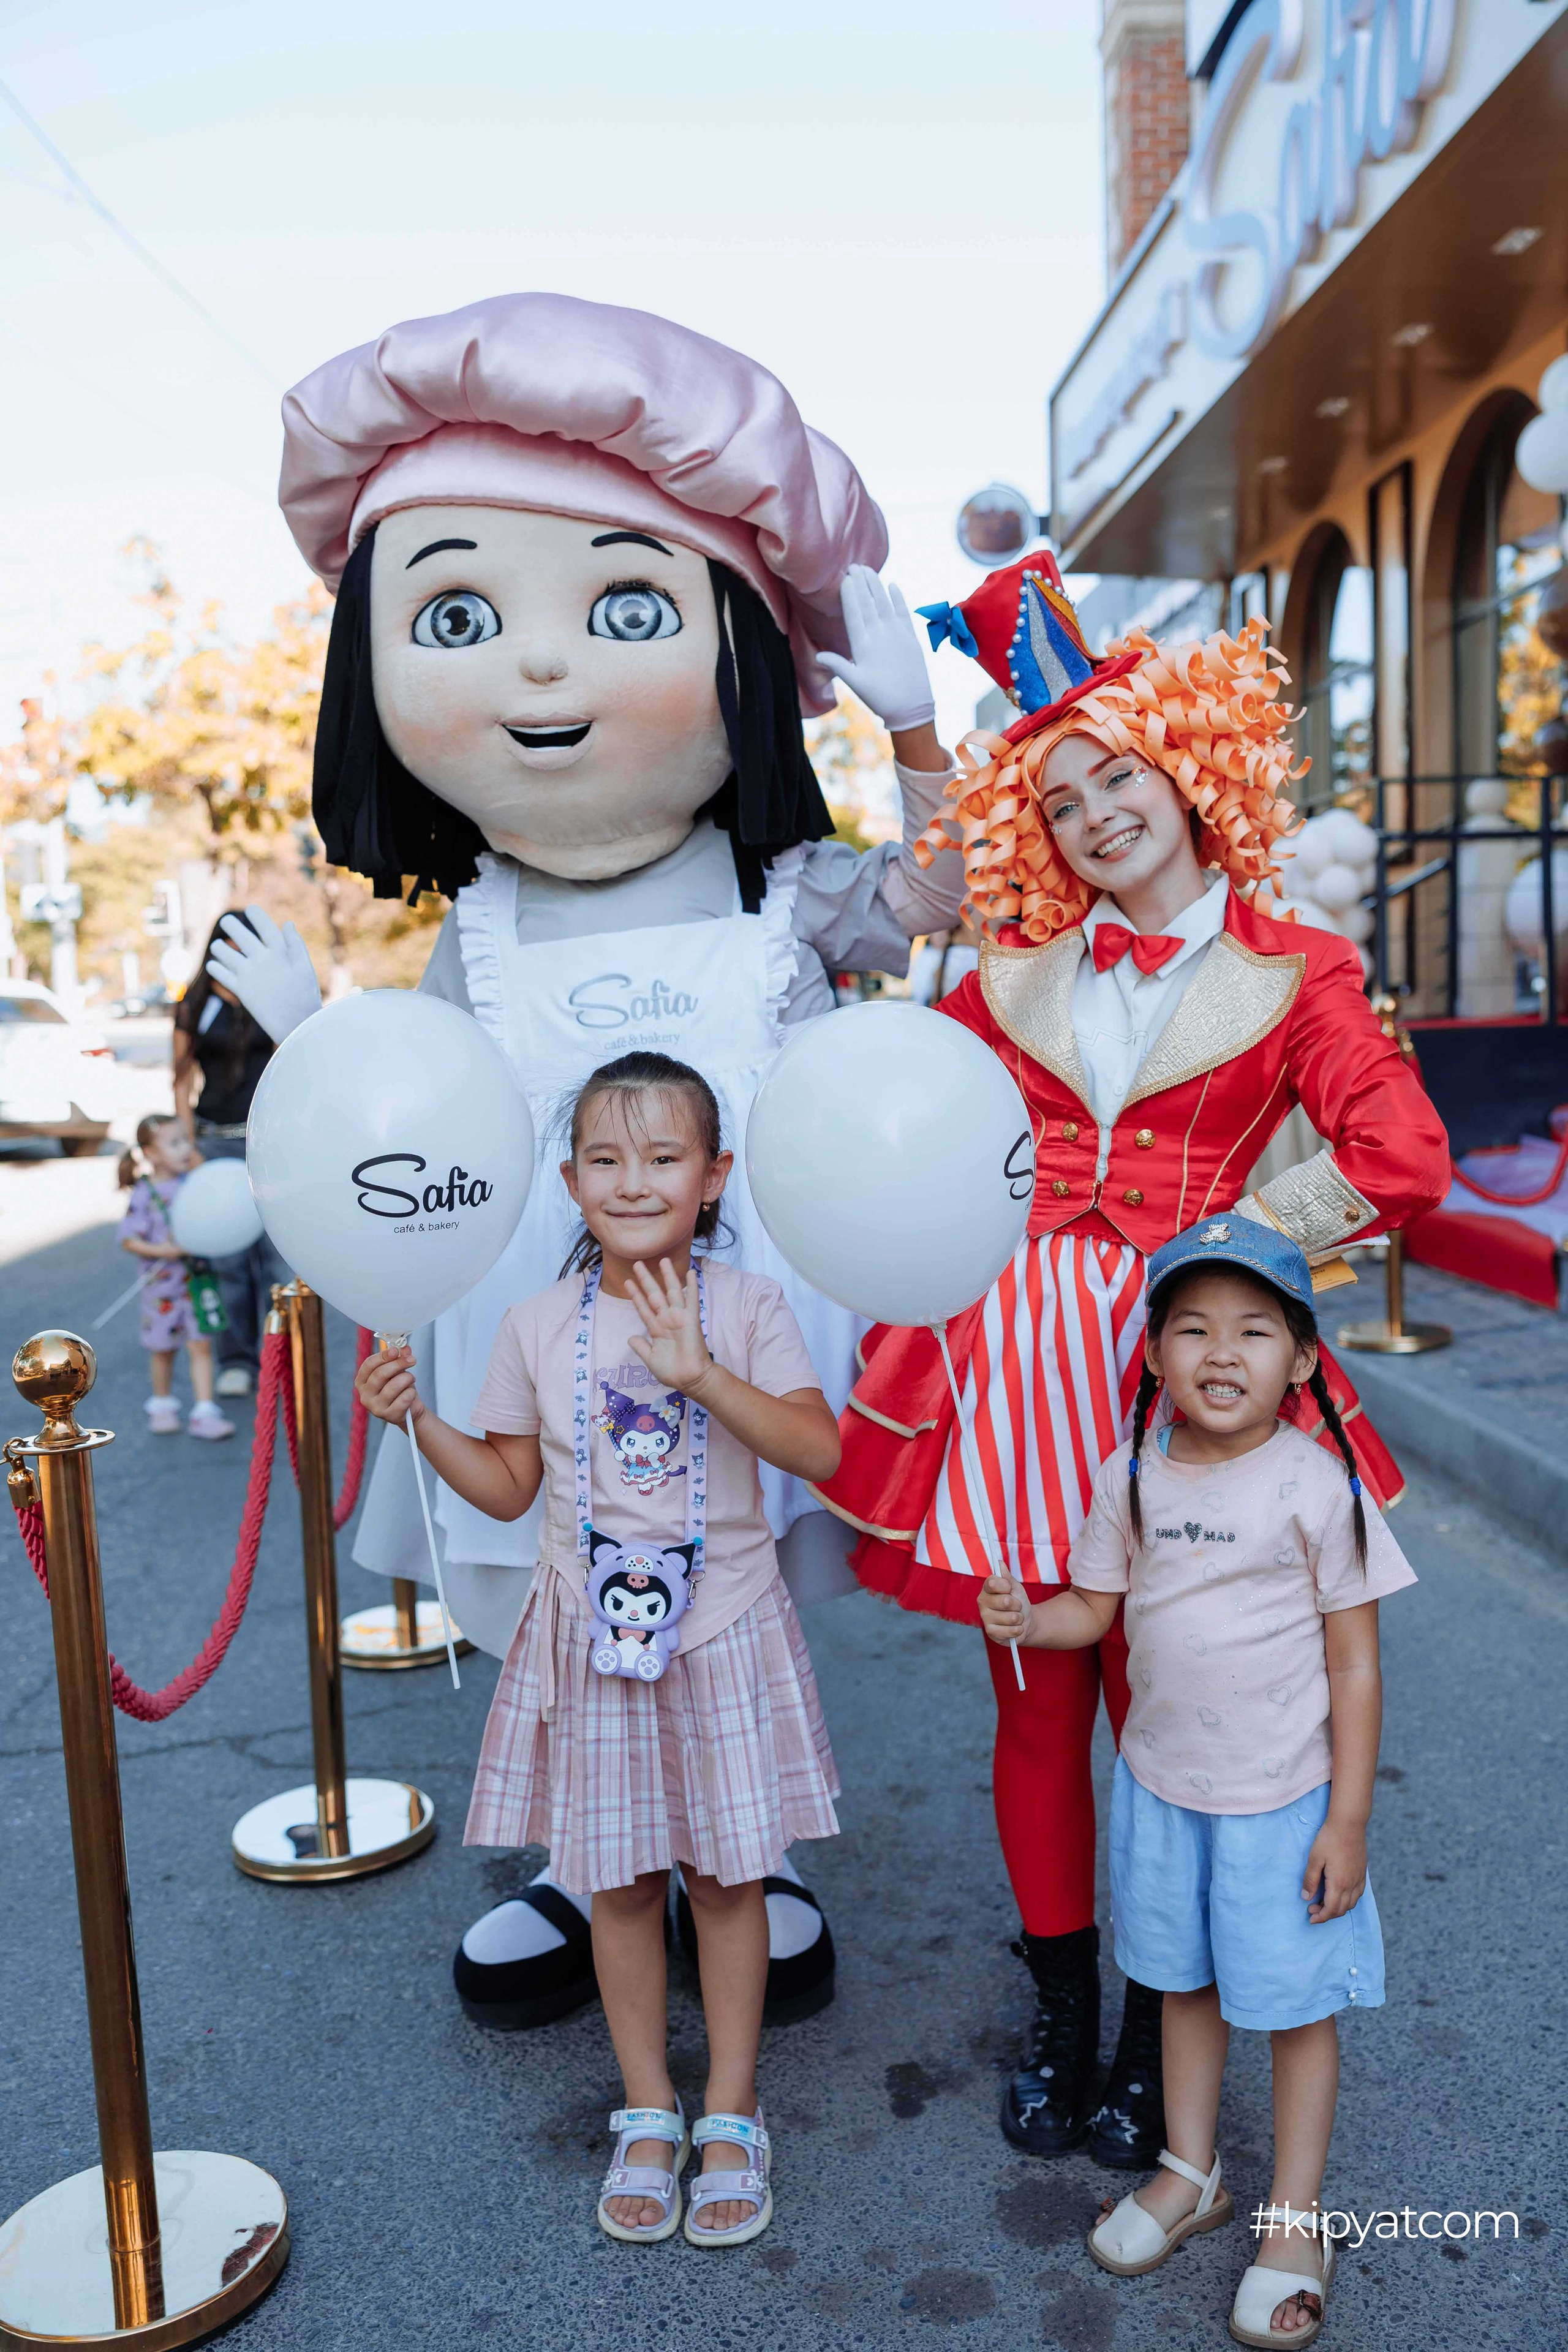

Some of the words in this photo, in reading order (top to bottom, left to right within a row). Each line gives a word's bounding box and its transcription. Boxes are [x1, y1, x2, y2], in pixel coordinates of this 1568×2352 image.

[569, 973, 698, 1028] Safia
[640, 1032, 680, 1045] bakery
[1004, 1131, 1036, 1200] S
[352, 1153, 493, 1218] Safia
[394, 1224, 415, 1233] café
[418, 1223, 425, 1232] &
[429, 1221, 459, 1231] bakery
[1204, 1531, 1236, 1543] MAD
